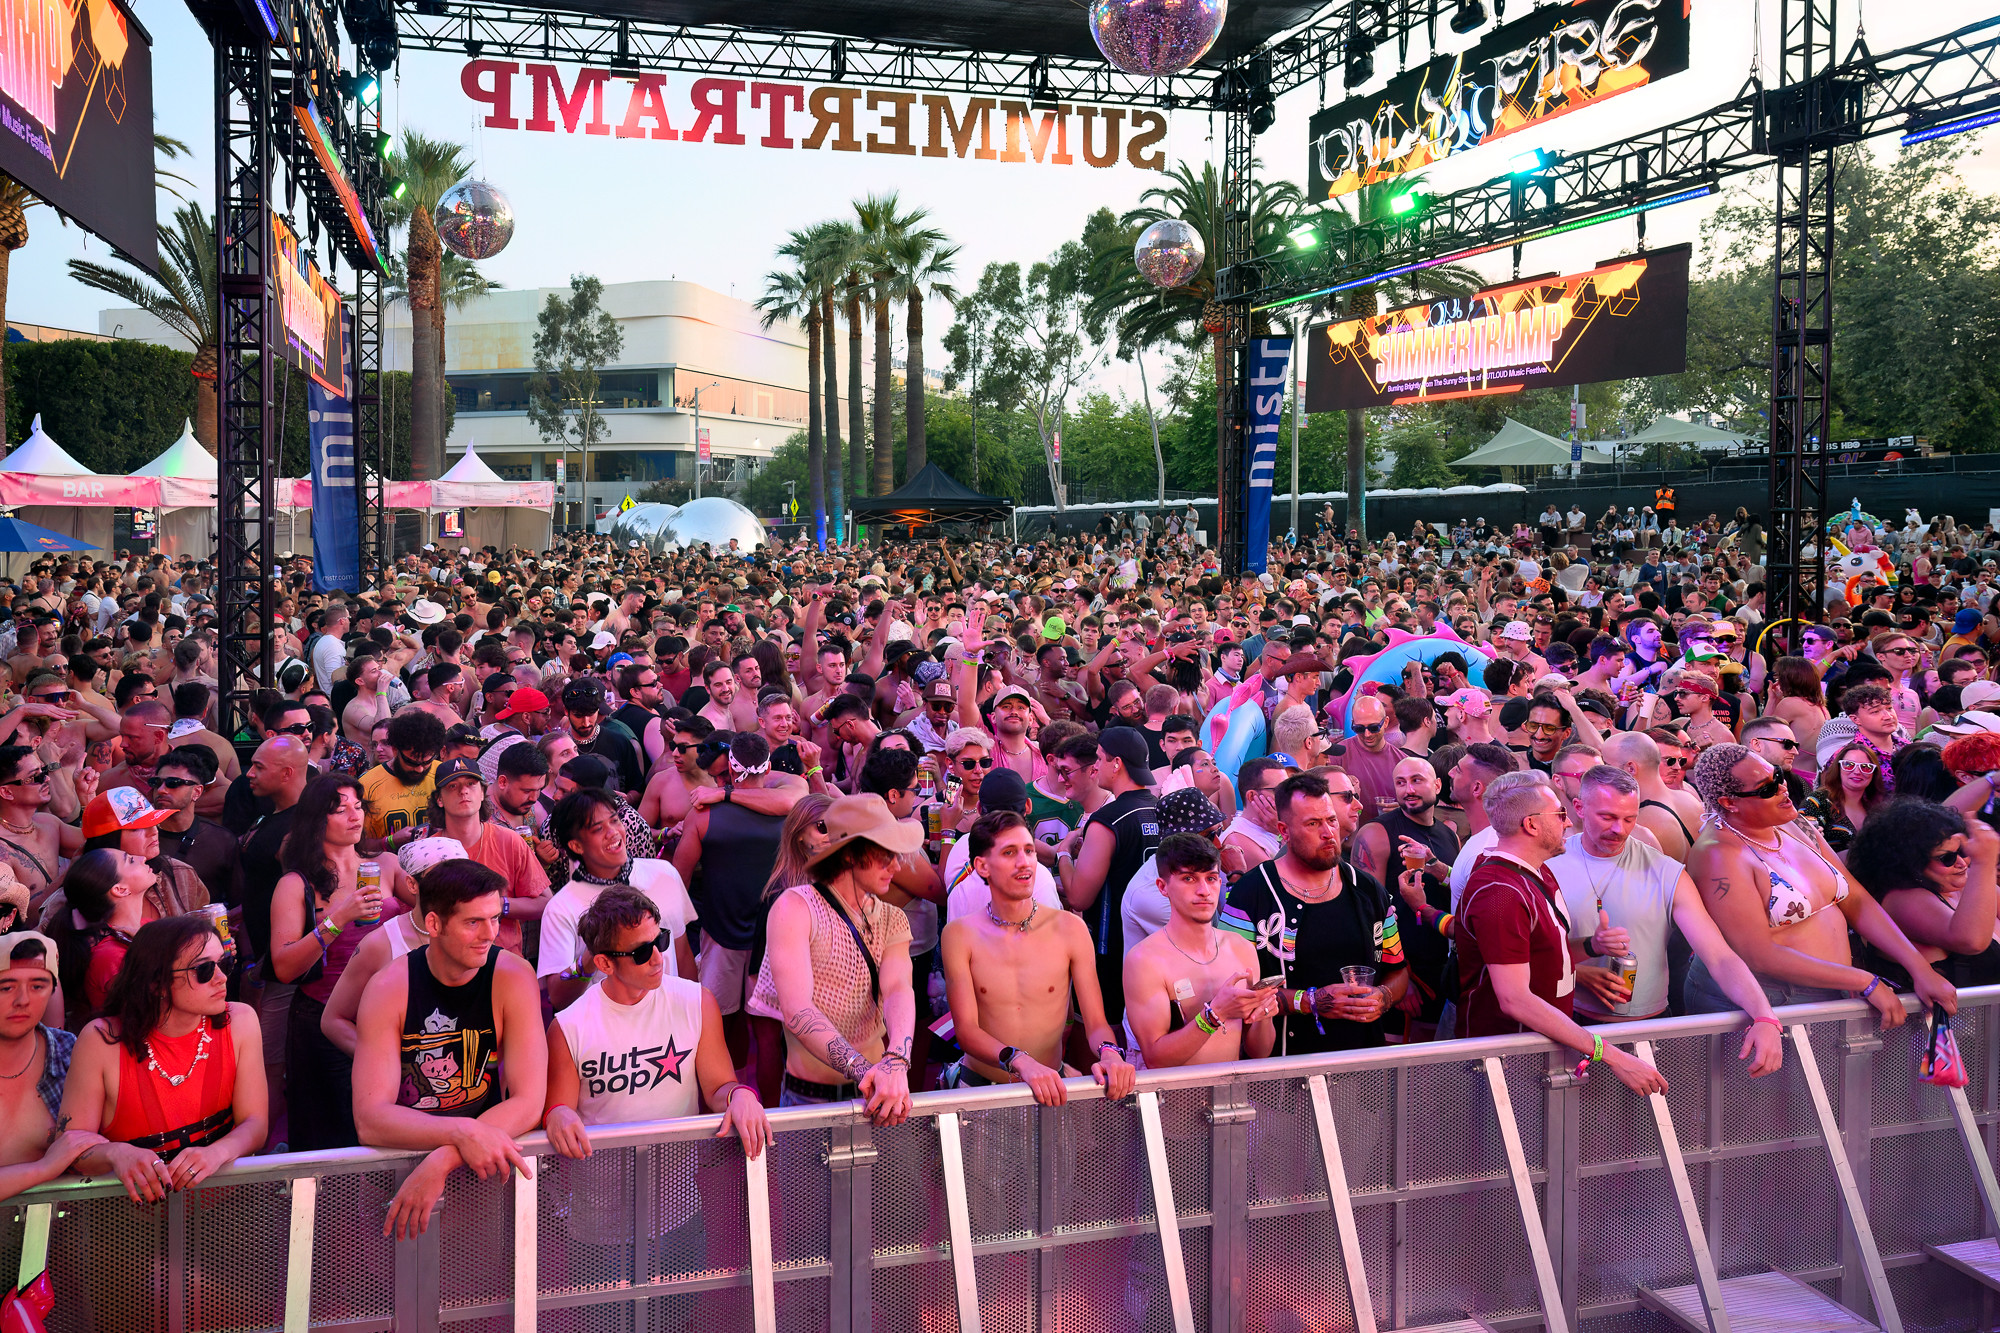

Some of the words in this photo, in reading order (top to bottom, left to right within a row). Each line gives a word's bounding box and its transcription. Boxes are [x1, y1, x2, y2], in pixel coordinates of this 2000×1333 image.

[1, 104, 26, 140] Music
[26, 124, 52, 161] Festival
[1376, 303, 1562, 384] SUMMERTRAMP
[1387, 384, 1404, 393] Burning
[1404, 382, 1421, 391] Brightly
[1443, 377, 1457, 385] Sunny
[1458, 375, 1475, 384] Shoes
[1476, 373, 1482, 381] of
[1483, 370, 1508, 380] UTLOUD
[1509, 367, 1525, 377] Music
[1526, 365, 1548, 375] Festival
[1244, 339, 1290, 488] mistr
[1841, 441, 1861, 450] HBO
[63, 481, 104, 498] BAR
[1274, 753, 1288, 763] LA
[581, 1046, 663, 1079] slut
[588, 1069, 651, 1098] pop
